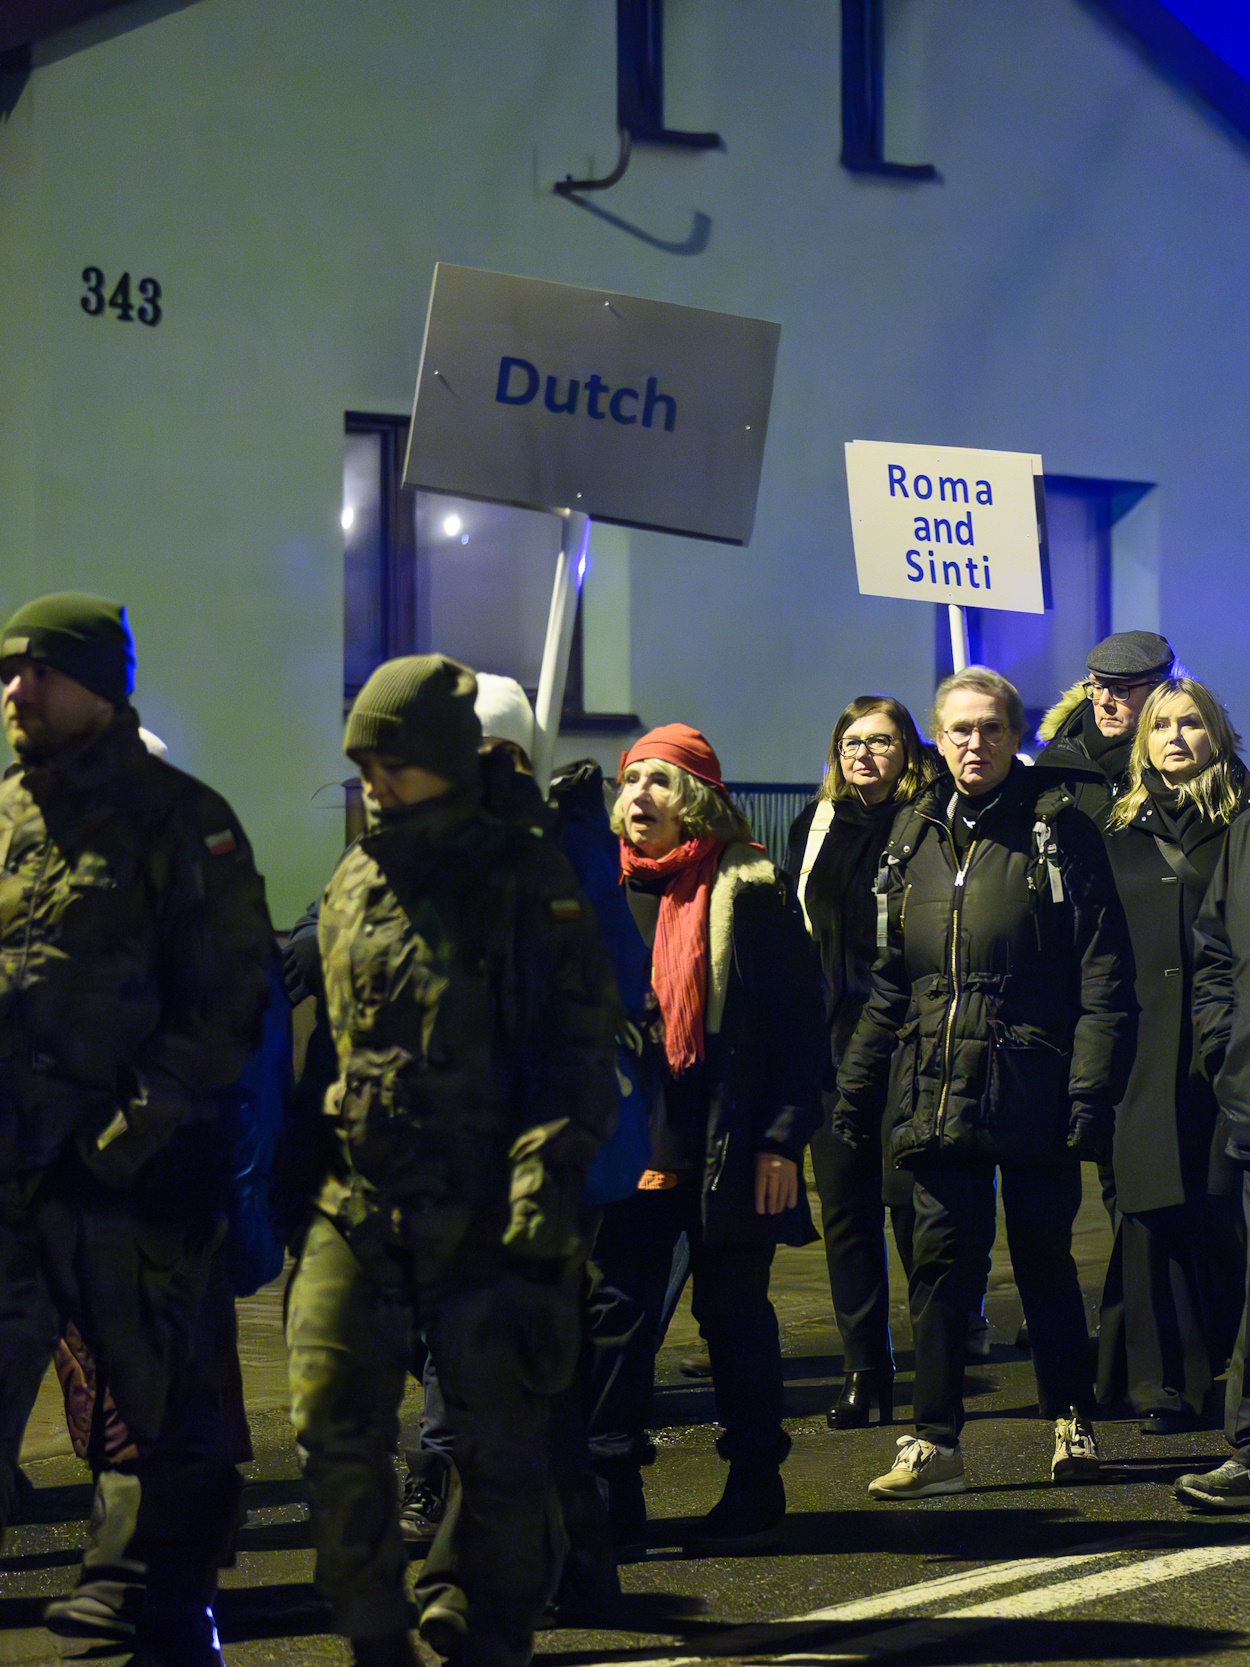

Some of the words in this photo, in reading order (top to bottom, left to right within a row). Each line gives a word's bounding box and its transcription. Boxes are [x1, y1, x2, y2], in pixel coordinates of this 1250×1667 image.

[81, 266, 162, 327] 343
[495, 356, 677, 432] Dutch
[888, 464, 993, 506] Roma
[914, 511, 974, 546] and
[906, 549, 991, 589] Sinti
